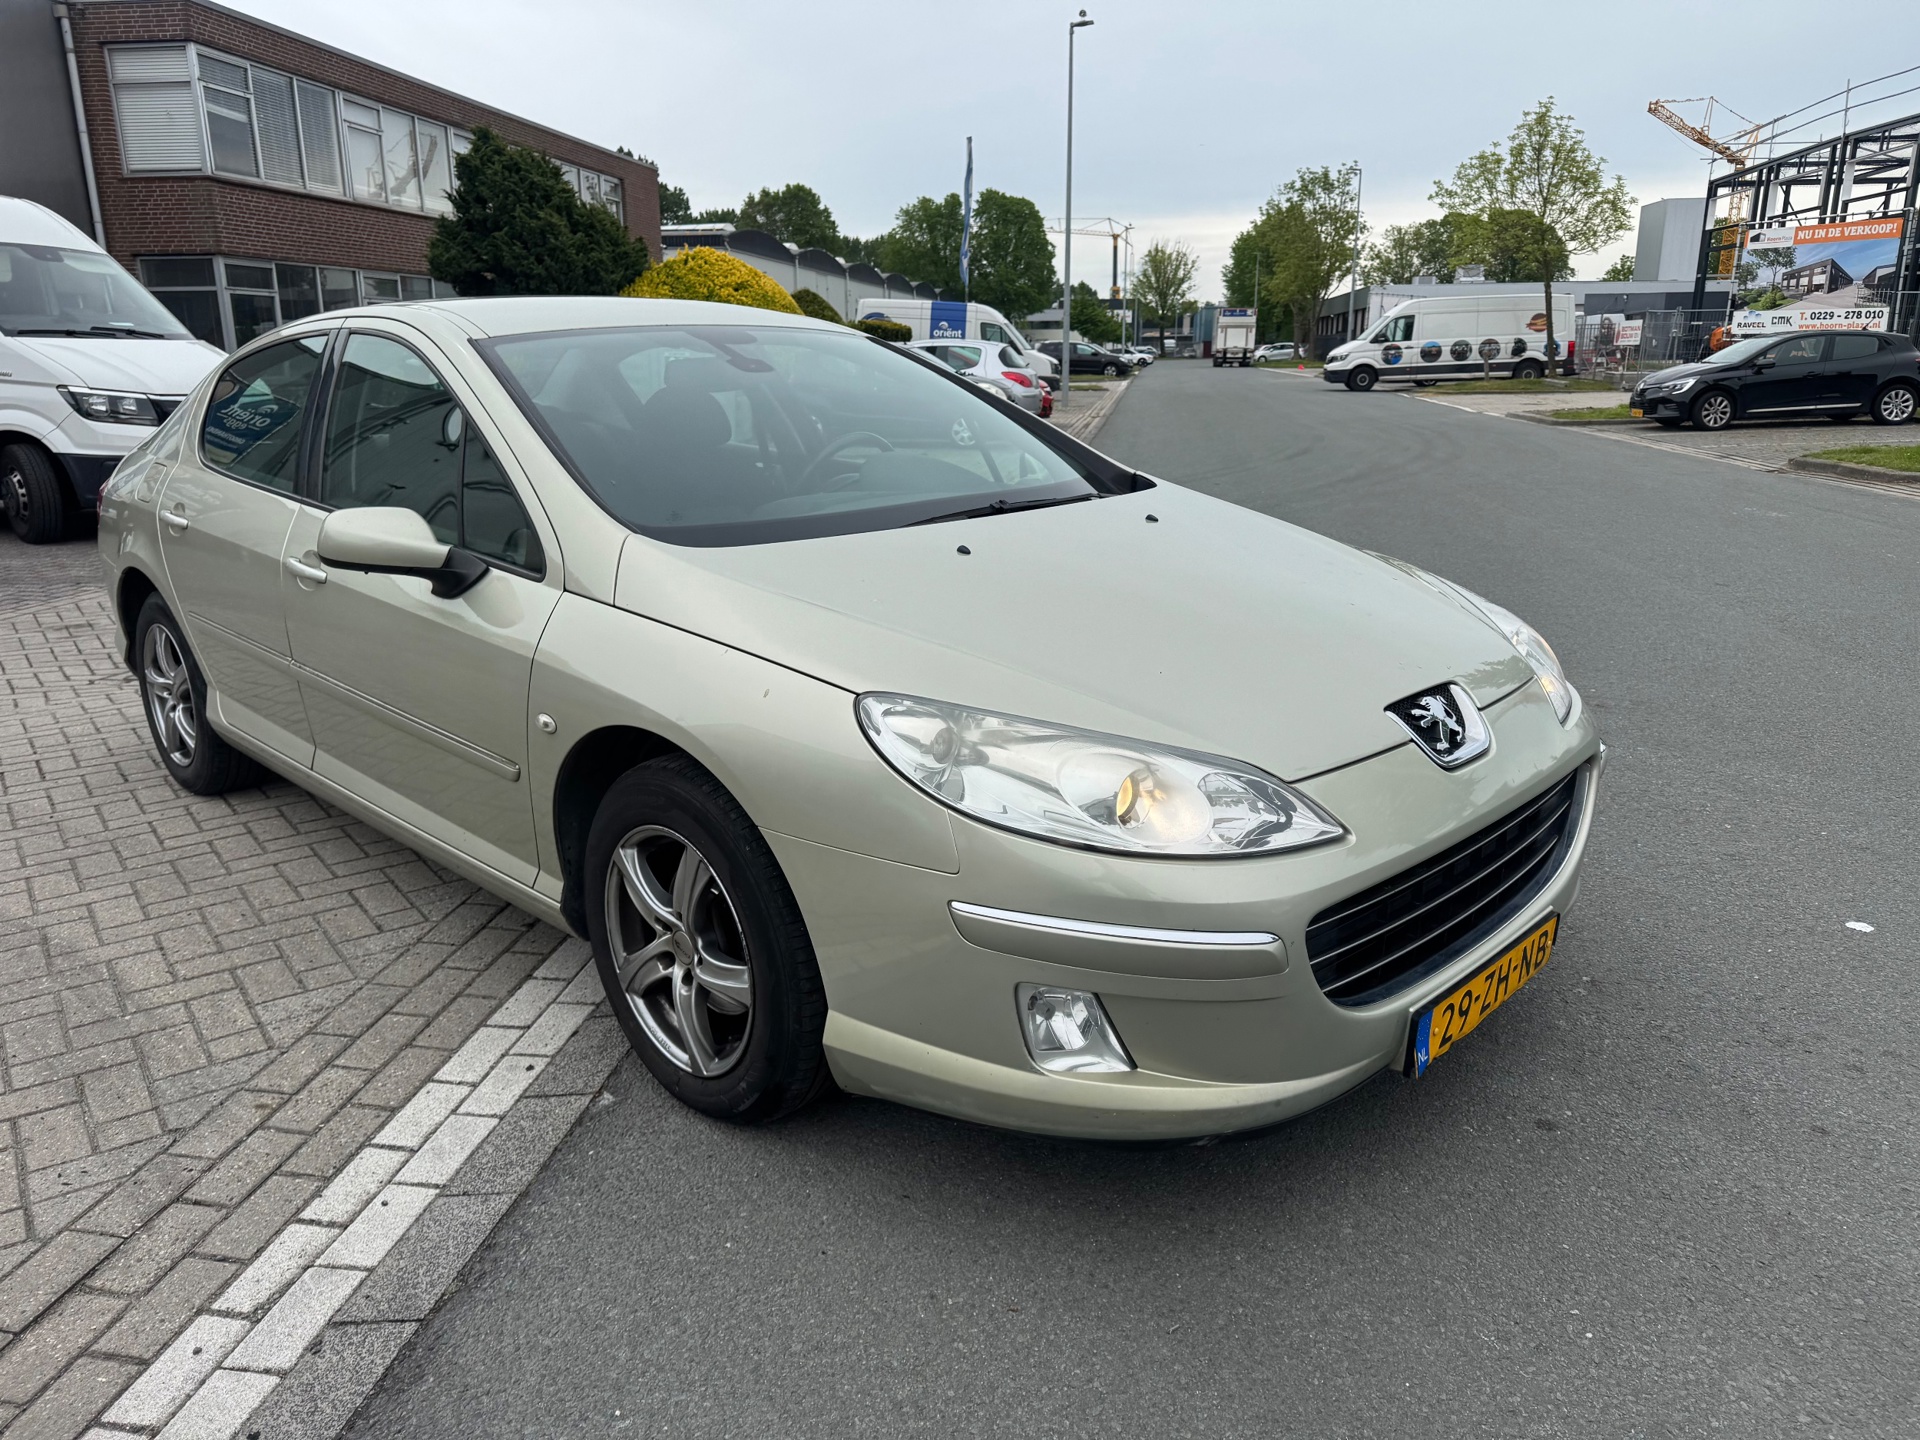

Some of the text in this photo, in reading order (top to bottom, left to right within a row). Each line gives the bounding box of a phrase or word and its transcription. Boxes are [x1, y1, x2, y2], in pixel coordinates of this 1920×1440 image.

[1797, 223, 1897, 240] NU IN DE VERKOOP!
[1799, 312, 1808, 320] T.
[1810, 311, 1834, 320] 0229
[1844, 310, 1863, 320] 278
[1864, 309, 1884, 319] 010
[1737, 321, 1766, 329] RAVEEL
[933, 328, 962, 338] oriënt
[1438, 929, 1549, 1050] 29-ZH-NB
[1417, 1047, 1428, 1066] NL
